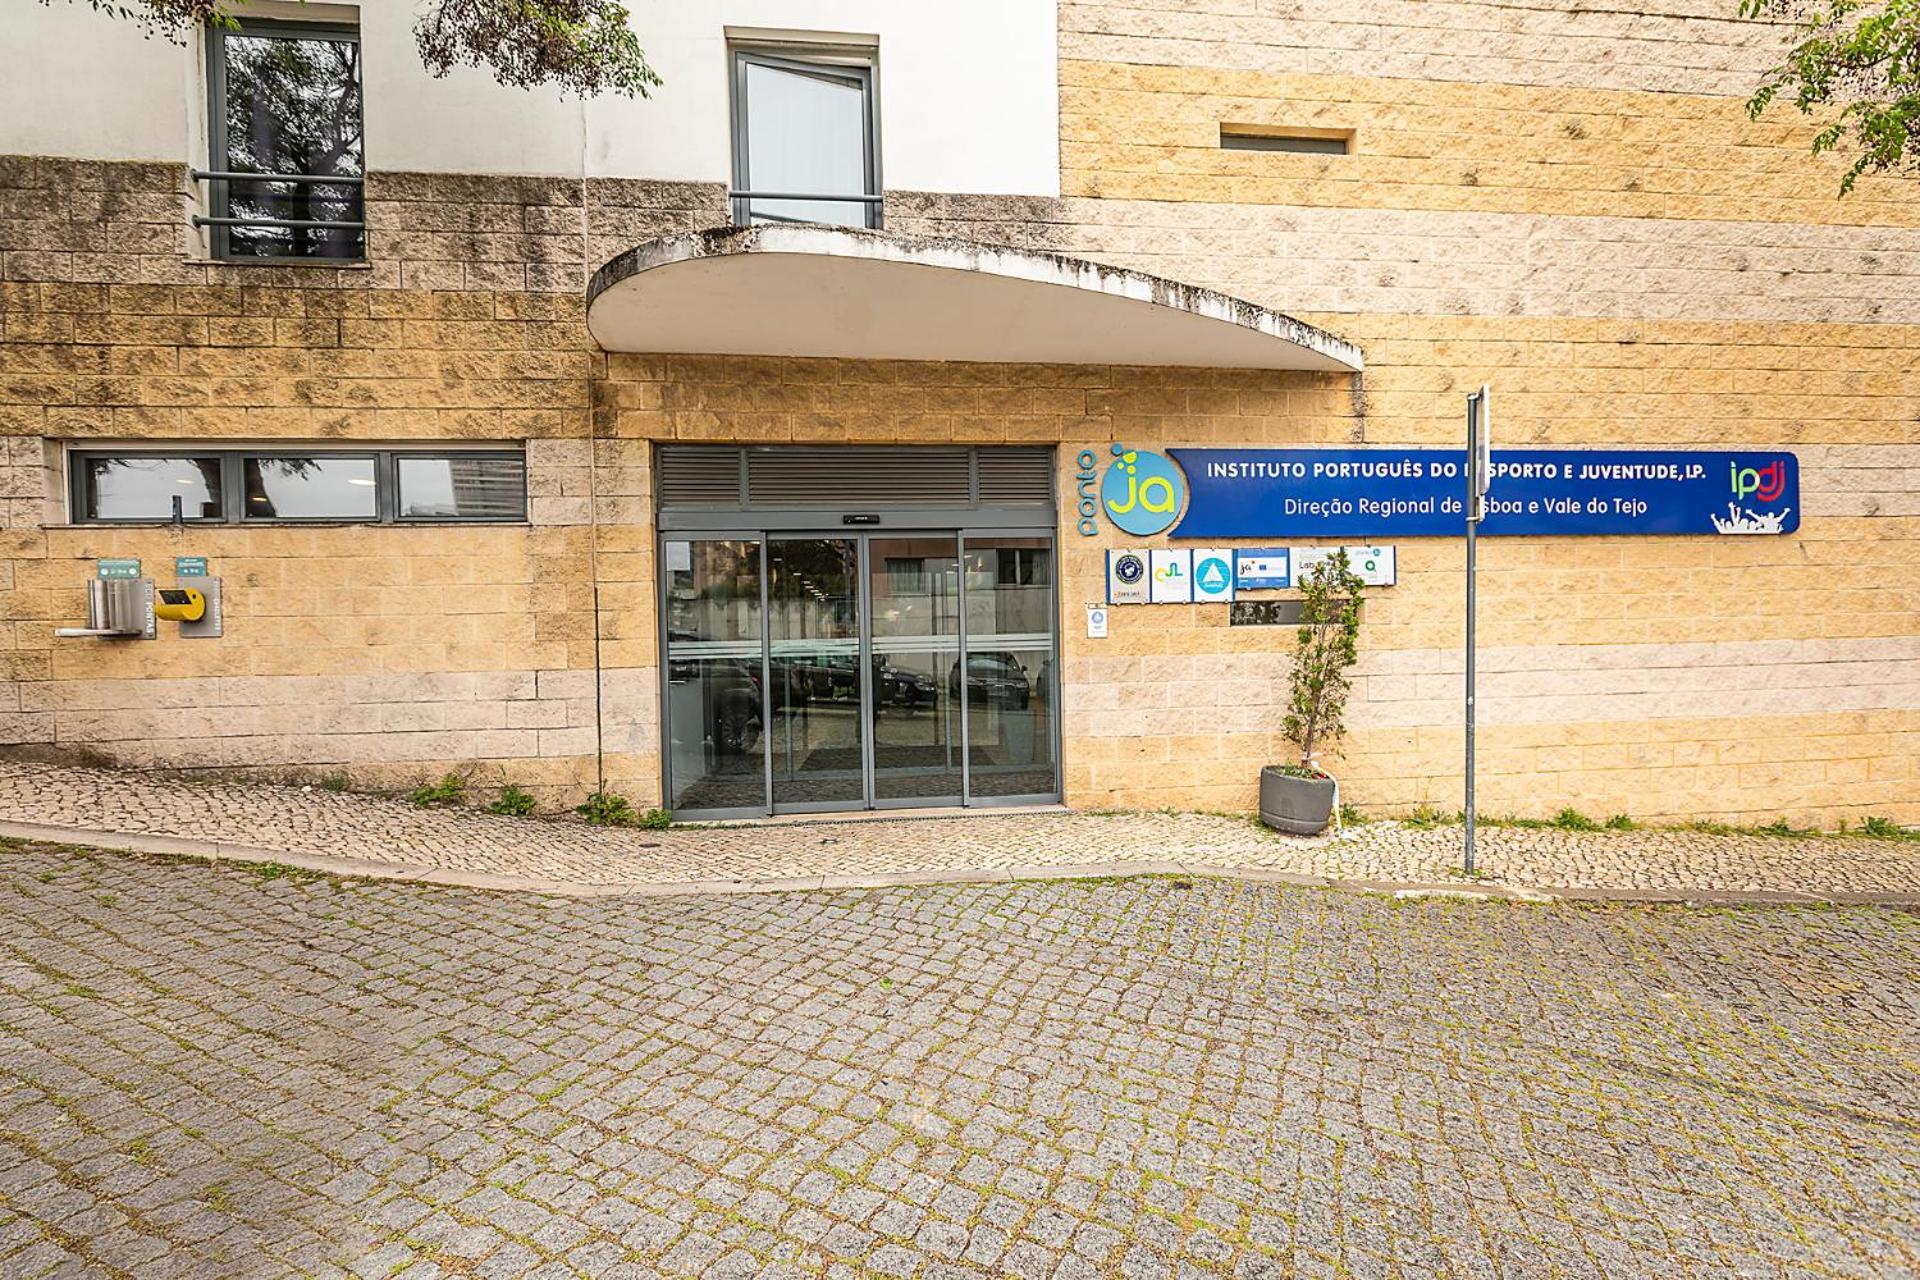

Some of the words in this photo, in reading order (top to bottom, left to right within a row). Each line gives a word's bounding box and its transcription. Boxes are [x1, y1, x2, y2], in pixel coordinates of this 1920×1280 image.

[1206, 462, 1306, 478] INSTITUTO
[1313, 459, 1423, 478] PORTUGUÊS
[1430, 462, 1457, 478] DO
[1464, 462, 1557, 479] SPORTO
[1563, 464, 1573, 479] E
[1730, 460, 1785, 502] ipdj
[1076, 449, 1098, 537] ponto
[1284, 498, 1353, 518] Direção
[1358, 497, 1434, 518] Regional
[1440, 497, 1462, 514] de
[1528, 501, 1539, 514] e
[1544, 497, 1581, 514] Vale
[1587, 497, 1608, 514] do
[1613, 498, 1647, 517] Tejo
